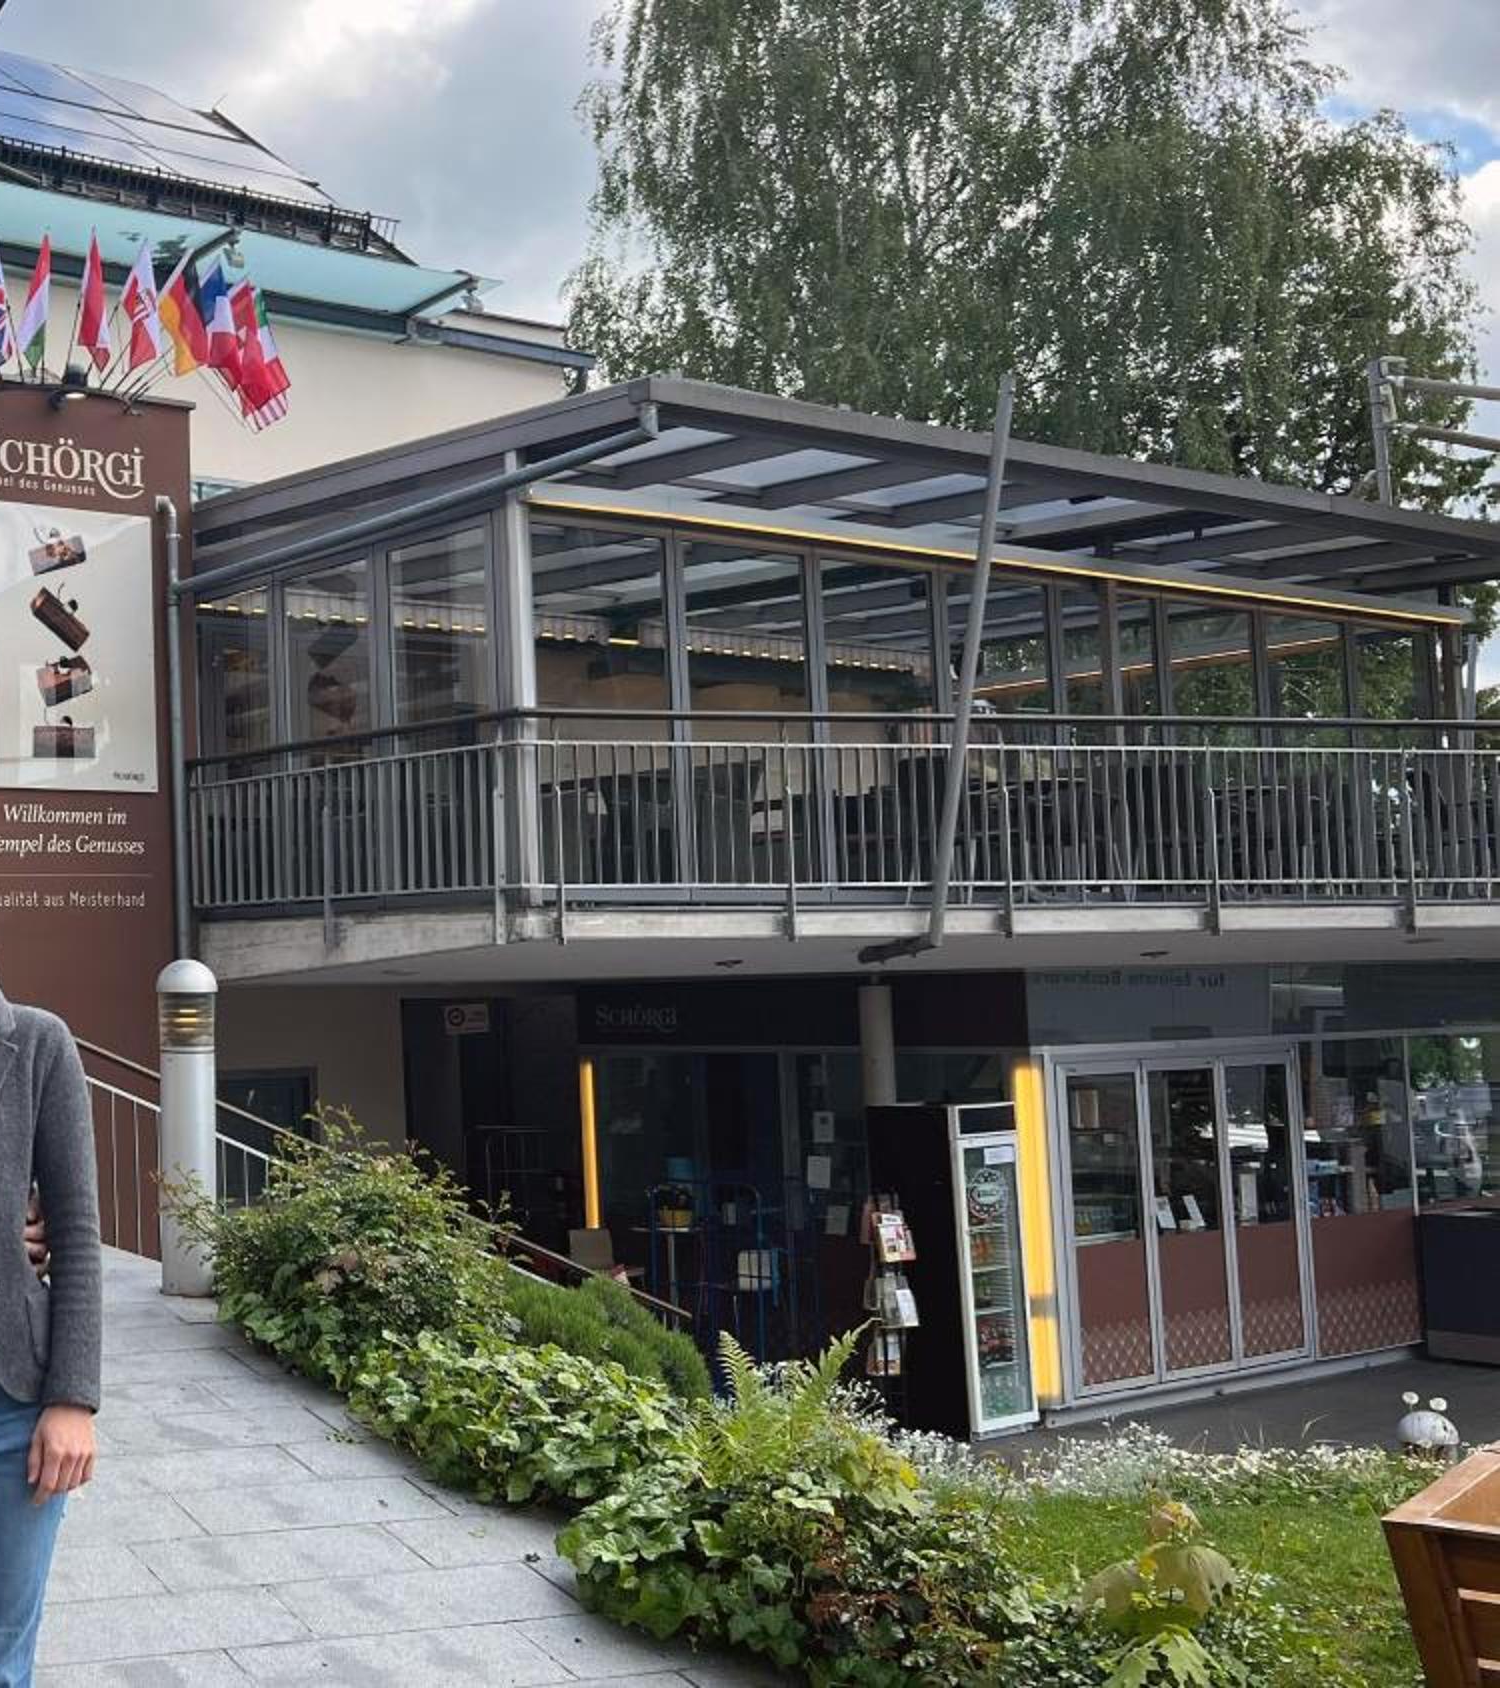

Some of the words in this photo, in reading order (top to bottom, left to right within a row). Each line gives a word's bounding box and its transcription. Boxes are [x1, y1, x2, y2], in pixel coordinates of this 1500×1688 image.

[19, 477, 39, 490] des
[43, 480, 96, 496] Genusses
[3, 803, 103, 825] Willkommen
[107, 806, 128, 825] im
[47, 834, 71, 853] des
[75, 835, 146, 854] Genusses
[44, 894, 65, 908] aus
[69, 891, 145, 908] Meisterhand
